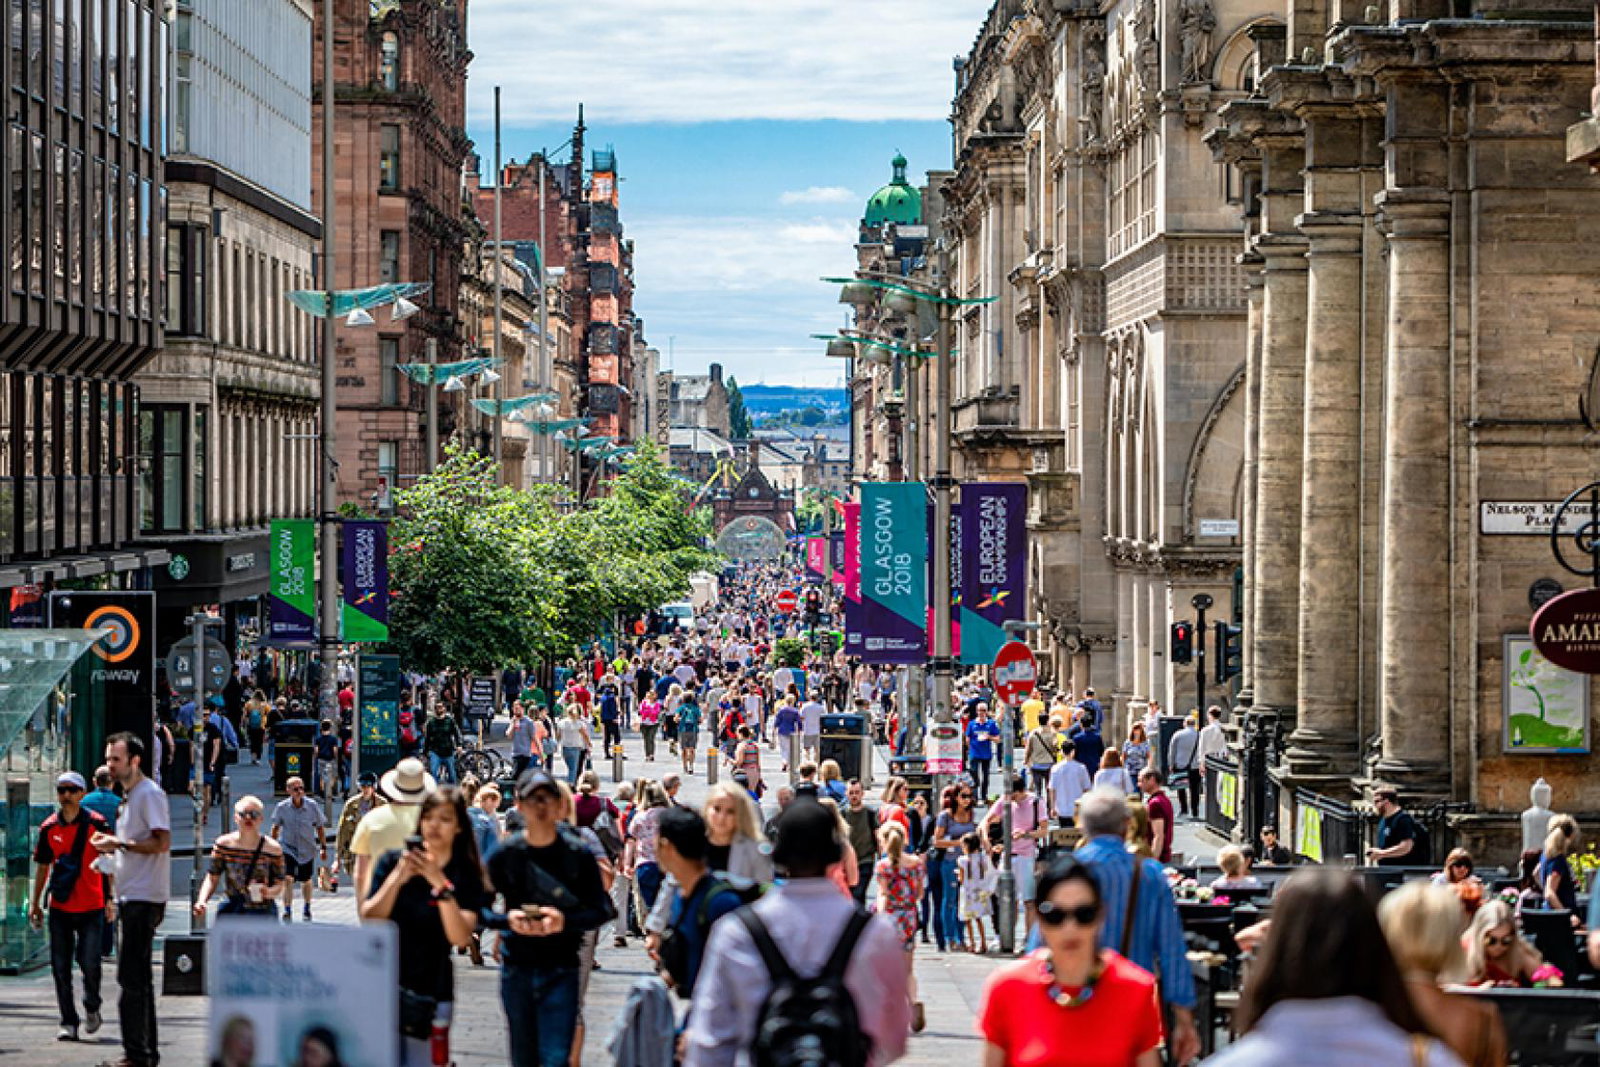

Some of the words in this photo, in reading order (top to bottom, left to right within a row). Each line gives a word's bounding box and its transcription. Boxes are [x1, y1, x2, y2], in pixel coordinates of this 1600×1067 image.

[979, 495, 995, 584] EUROPEAN
[1487, 504, 1536, 514] NELSON
[279, 529, 293, 596] GLASGOW
[874, 497, 893, 596] GLASGOW
[894, 552, 911, 596] 2018
